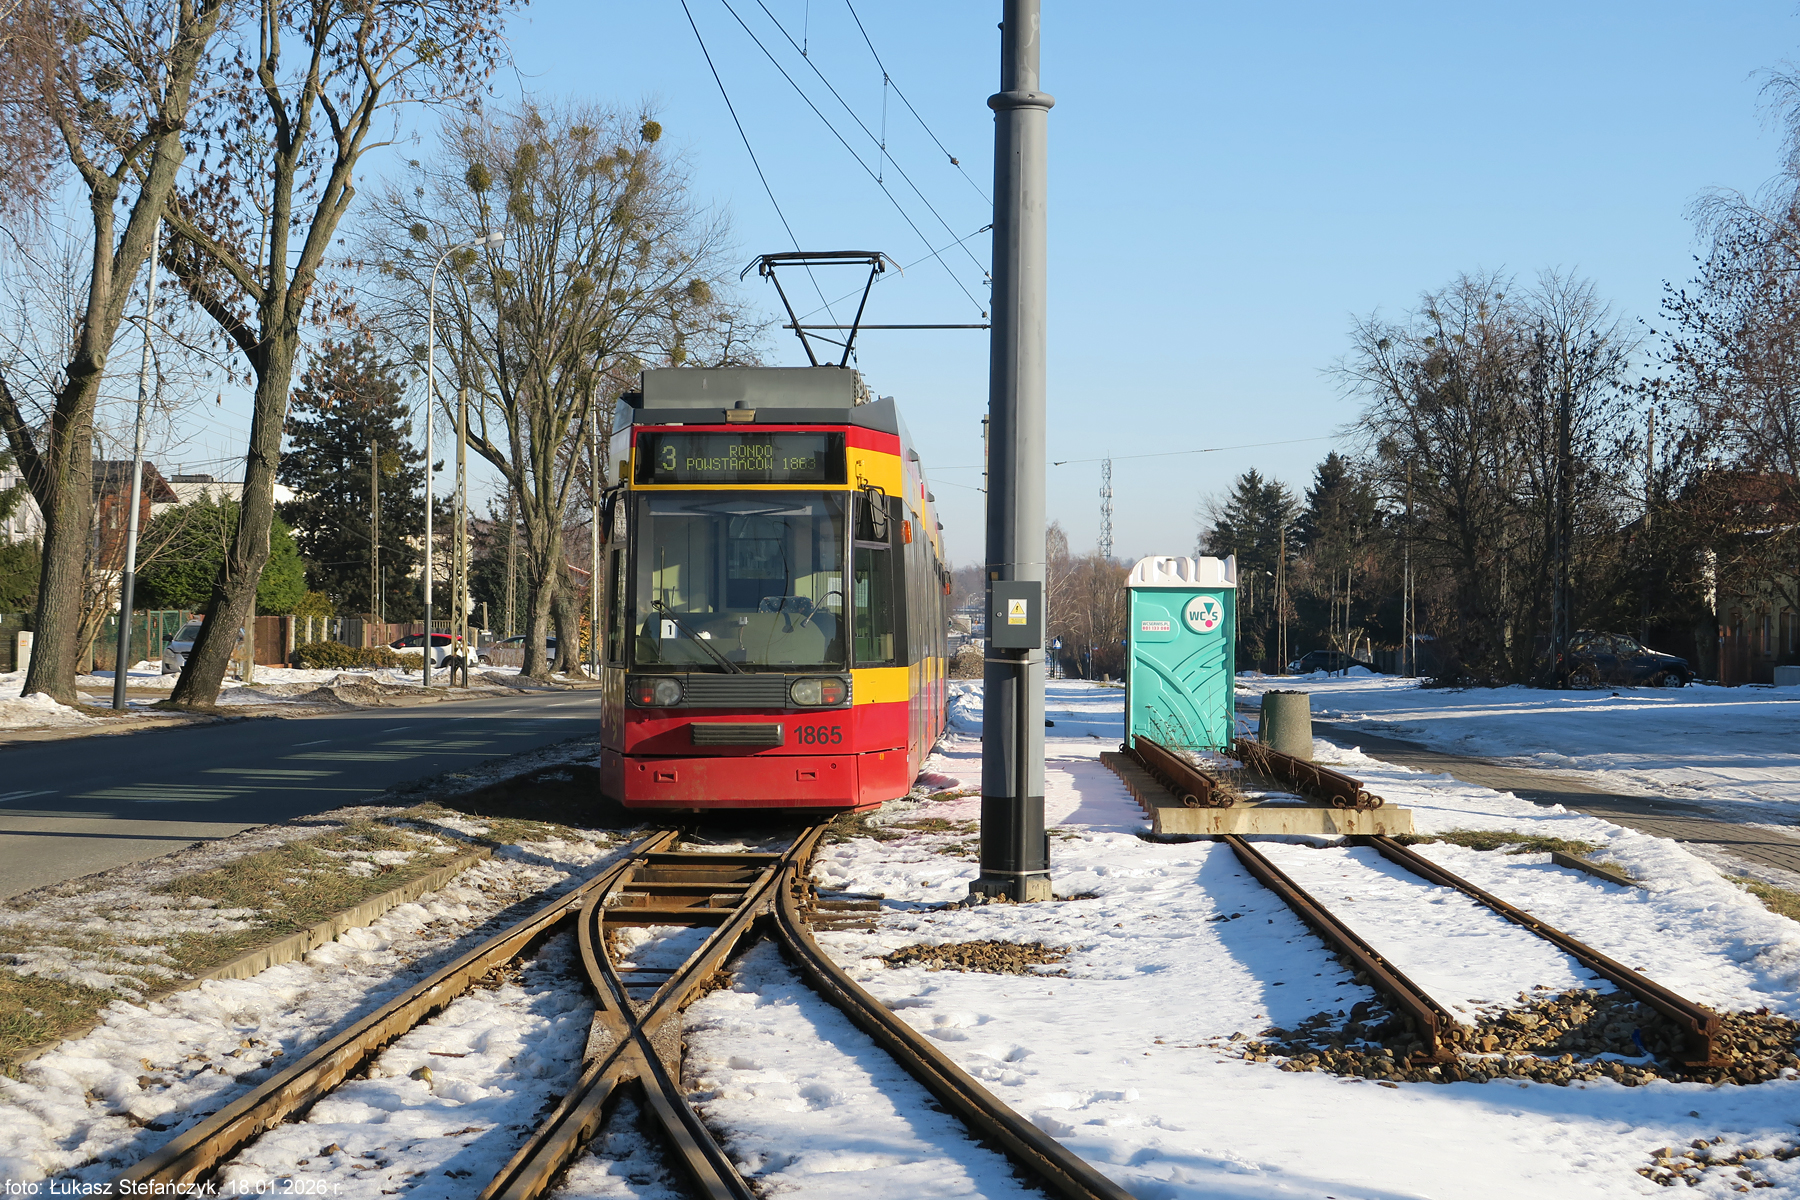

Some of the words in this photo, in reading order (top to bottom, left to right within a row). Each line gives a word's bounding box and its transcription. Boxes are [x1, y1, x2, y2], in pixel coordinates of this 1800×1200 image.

[662, 445, 677, 471] 3
[729, 444, 773, 458] RONDO
[783, 457, 816, 470] 1863
[667, 624, 673, 636] 1
[794, 725, 843, 744] 1865
